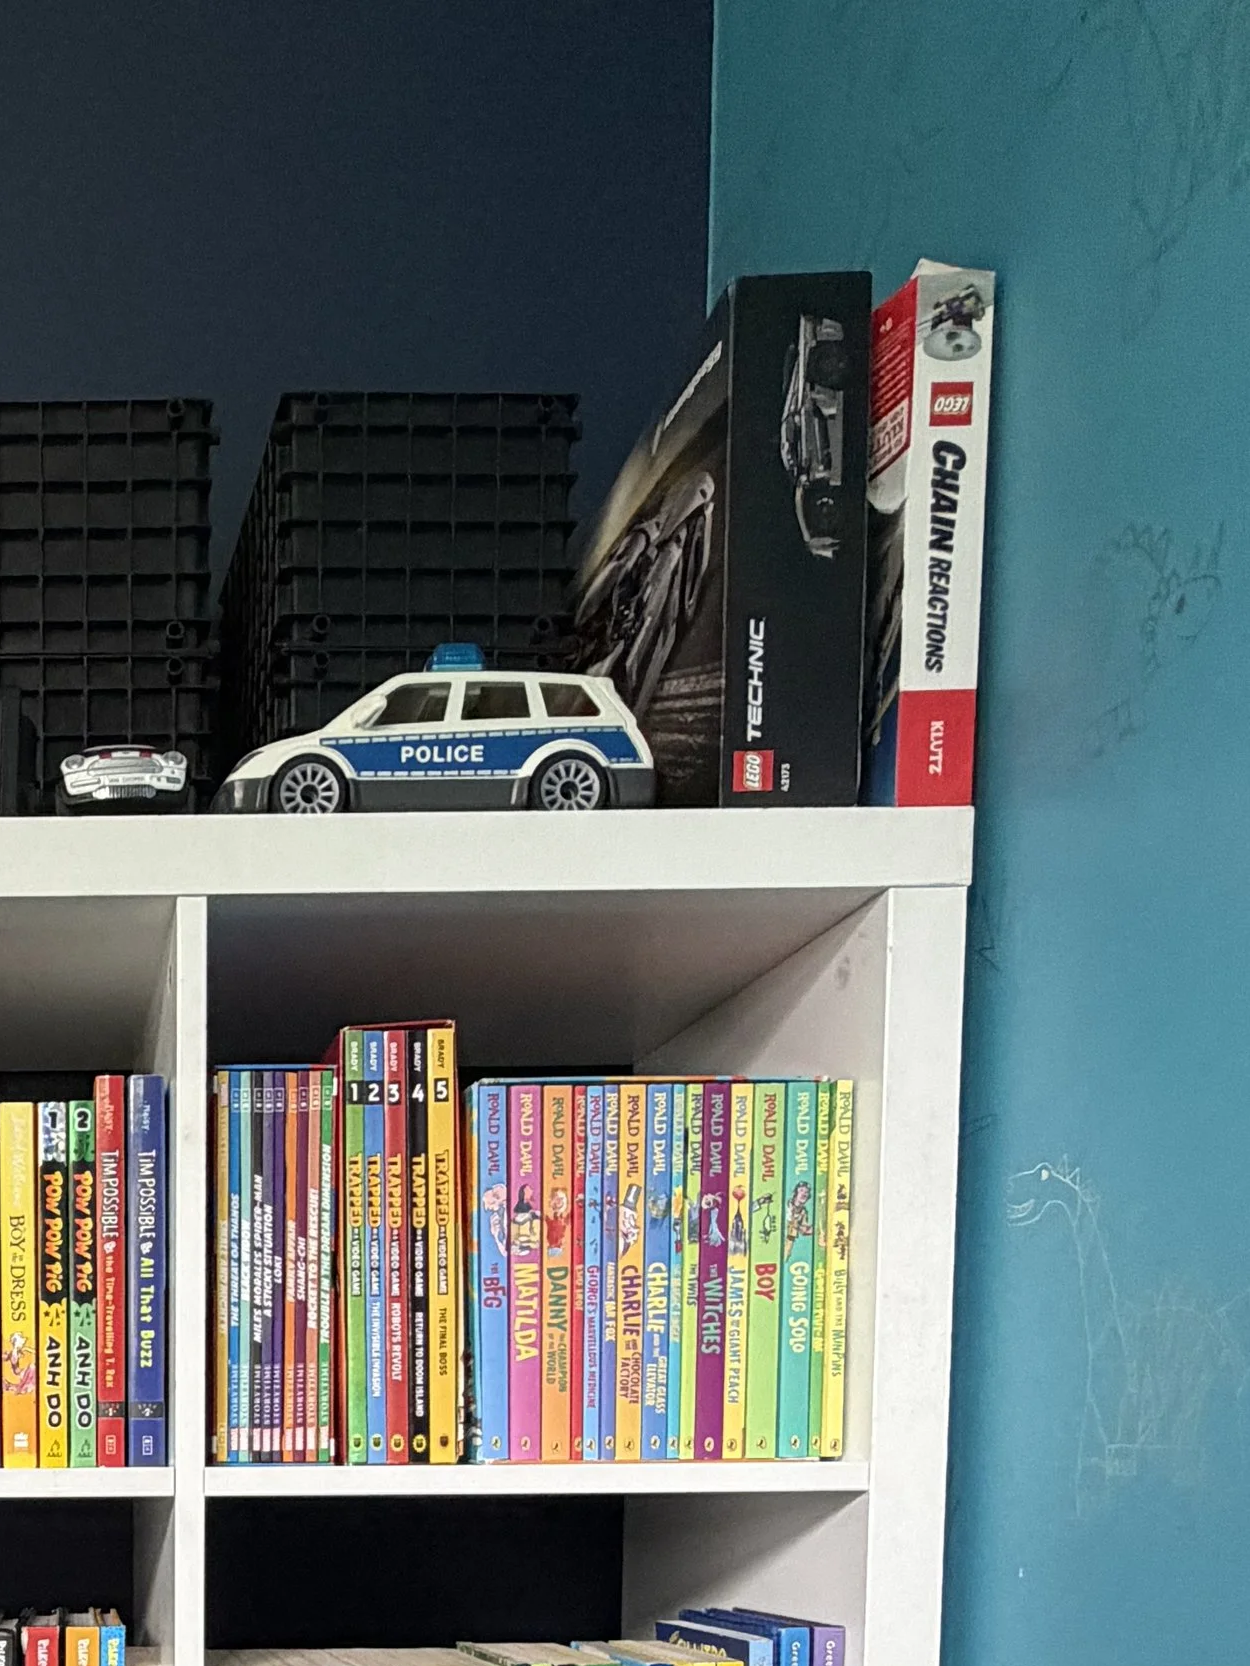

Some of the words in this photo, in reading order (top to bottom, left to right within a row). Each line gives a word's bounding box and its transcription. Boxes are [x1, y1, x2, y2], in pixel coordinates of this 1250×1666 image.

[934, 396, 969, 413] LEGO
[929, 440, 966, 553] CHAIN
[925, 557, 952, 673] REACTIONS
[747, 619, 764, 742] TECHNIC
[401, 745, 484, 763] POLICE
[929, 720, 944, 775] KLUTZ
[745, 753, 762, 788] LEGO
[351, 1083, 358, 1101] 1
[368, 1084, 379, 1101] 2
[389, 1084, 399, 1102] 3
[412, 1084, 424, 1102] 4
[437, 1081, 447, 1099] 5
[50, 1111, 57, 1130] 1
[76, 1109, 90, 1132] 2
[488, 1093, 500, 1135] ROALD
[520, 1093, 533, 1135] ROALD
[553, 1097, 565, 1139] ROALD
[590, 1095, 601, 1138] ROALD
[488, 1141, 499, 1175] DAHL
[520, 1141, 532, 1176] DAHL
[552, 1144, 564, 1179] DAHL
[590, 1142, 601, 1177] DAHL
[44, 1171, 62, 1214] POW
[74, 1171, 92, 1214] POW
[349, 1154, 362, 1227] TRAPPED
[368, 1154, 381, 1227] TRAPPED
[388, 1154, 401, 1227] TRAPPED
[412, 1154, 425, 1227] TRAPPED
[435, 1150, 448, 1225] TRAPPED
[9, 1216, 26, 1252] BOY
[45, 1217, 61, 1260] POW
[75, 1217, 91, 1260] POW
[273, 1256, 282, 1283] LOKI
[297, 1237, 305, 1301] SHANG-CHI
[755, 1263, 776, 1301] BOY
[790, 1261, 806, 1313] GOING
[9, 1265, 26, 1322] DRESS
[483, 1277, 505, 1308] BFG
[513, 1263, 538, 1361] MATILDA
[547, 1266, 568, 1332] DANNY
[621, 1265, 641, 1336] CHARLIE
[647, 1262, 668, 1333] CHARLIE
[729, 1265, 744, 1317] JAMES
[391, 1302, 400, 1342] ROBOTS
[415, 1312, 423, 1345] RETURN
[702, 1278, 722, 1354] WITCHES
[789, 1317, 806, 1353] SOLO
[46, 1336, 62, 1386] ANH
[75, 1336, 91, 1386] ANH
[391, 1345, 401, 1381] REVOLT
[415, 1347, 423, 1357] TO
[546, 1351, 556, 1384] WORLD
[558, 1343, 567, 1392] CHAMPION
[729, 1329, 741, 1364] GIANT
[620, 1357, 631, 1399] FACTORY
[629, 1351, 641, 1404] CHOCOLATE
[727, 1368, 740, 1404] PEACH
[46, 1393, 62, 1427] DO
[77, 1393, 92, 1427] DO
[415, 1386, 423, 1416] ISLAND
[655, 1386, 666, 1414] GLASS
